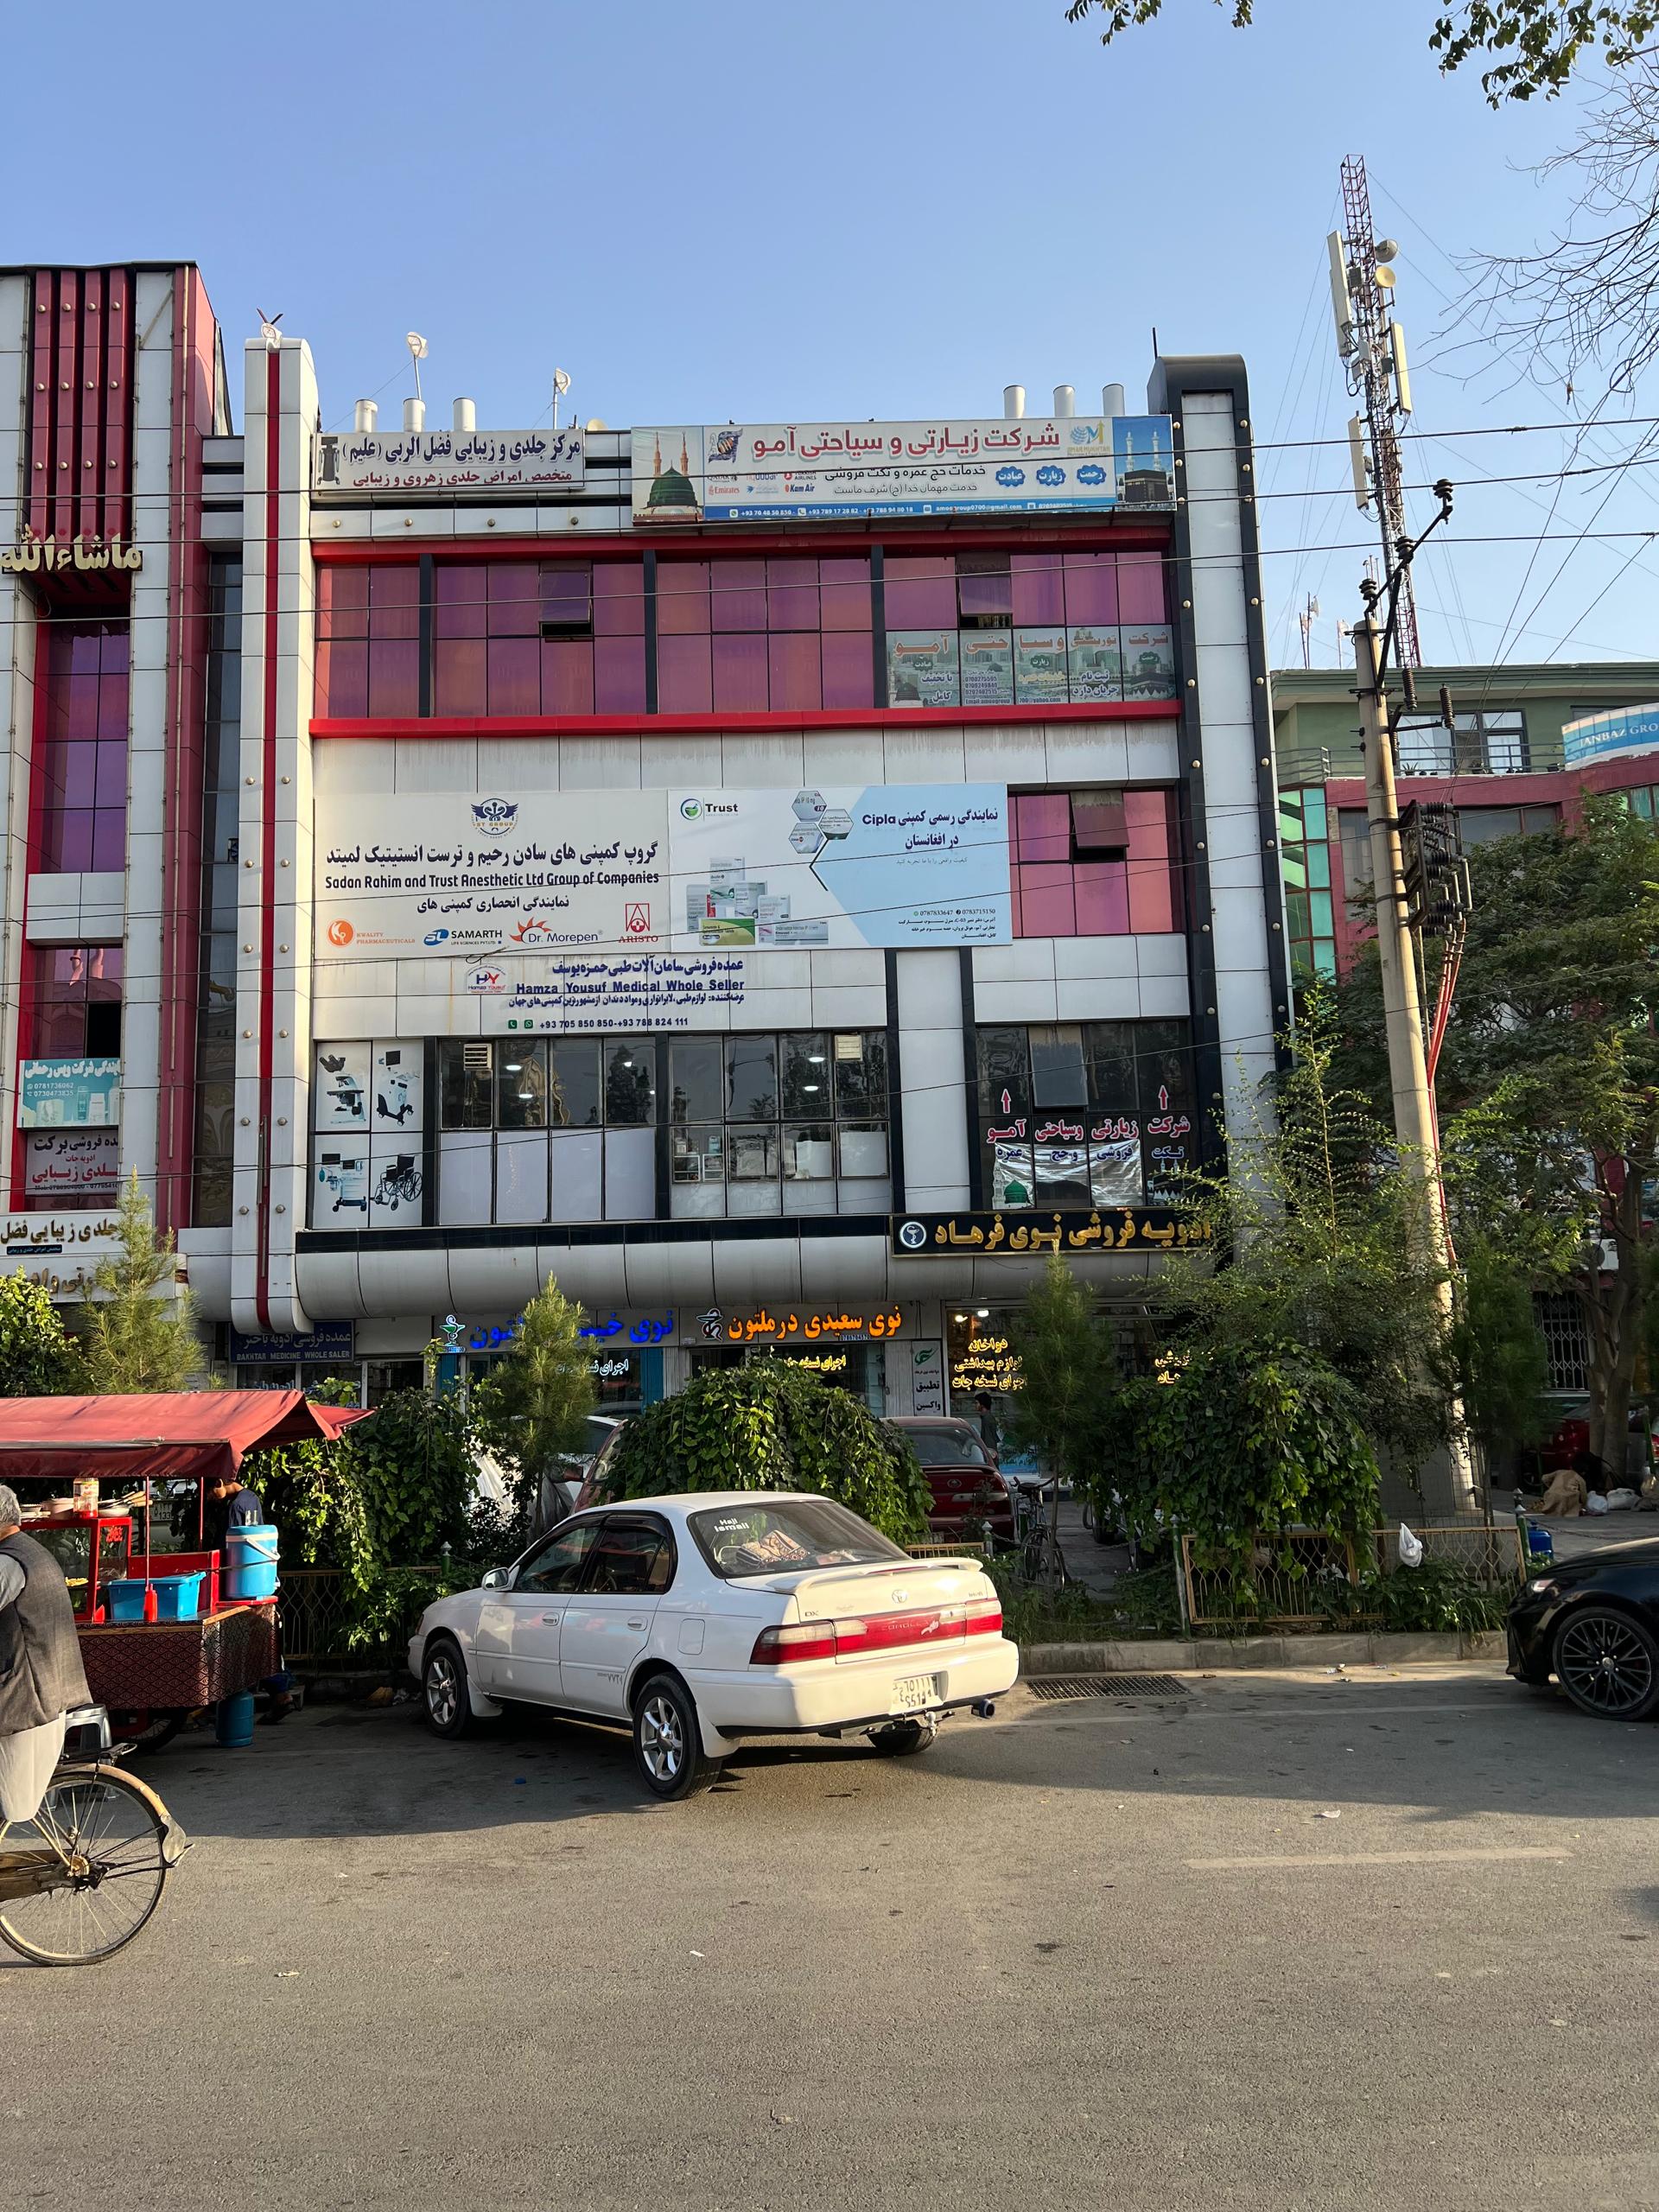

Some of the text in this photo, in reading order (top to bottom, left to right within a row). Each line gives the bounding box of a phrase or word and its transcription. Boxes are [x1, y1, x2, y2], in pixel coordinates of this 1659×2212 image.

[385, 435, 420, 462] الربی
[423, 433, 452, 462] فضل
[455, 435, 495, 461] زیبایی
[510, 436, 546, 462] جلدی
[550, 434, 581, 462] مرکز
[753, 423, 1060, 458] شرکت زیارتی و سیاحتی آمو
[499, 444, 505, 461] و
[903, 468, 928, 480] عمره
[931, 467, 946, 481] حج
[949, 463, 986, 476] خدمات
[998, 471, 1023, 481] عبادت
[1039, 469, 1063, 482] زیارت
[1079, 469, 1103, 480] رحمت
[790, 484, 804, 493] Kam
[804, 483, 816, 493] Air
[919, 483, 948, 493] مهمان
[950, 483, 977, 493] خدمت
[1128, 631, 1169, 647] شرکت
[1081, 670, 1110, 683] ثبت نام
[932, 690, 951, 703] کامل
[1580, 721, 1659, 748] JANBAZ GRO
[705, 803, 739, 812] Trust
[861, 813, 896, 827] Cipla
[898, 808, 998, 827] نمایندگی رسمی کمپنی
[905, 832, 959, 850] در افغانستان
[327, 840, 658, 868] گروپ کمپنی های سادن رحیم و ترست لمیتد
[325, 870, 659, 889] Sadan Rahim and Trust Anesthetic Ltd Group of Companies
[416, 895, 569, 913] نمایندگی انحصاری کمپنی های
[451, 930, 503, 939] SAMARTH
[528, 932, 599, 944] Dr. Morepen
[618, 935, 659, 944] ARISTO
[607, 959, 632, 976] طبی
[654, 957, 684, 975] سامان
[683, 957, 717, 976] فروشی
[516, 979, 745, 995] Hamza Yousuf Medical Whole Seller
[539, 1017, 689, 1029] +93 705 850 788 824 111
[986, 1118, 1027, 1144] آمو
[1090, 1116, 1140, 1141] زیارتی
[1147, 1116, 1192, 1138] شرکت
[34, 1134, 102, 1155] فروشی برکت
[1096, 1145, 1134, 1161] فروشی
[1151, 1146, 1185, 1160] تکت
[996, 1147, 1024, 1162] عمره
[32, 1164, 79, 1184] زیبایی
[934, 1212, 1005, 1250] فرهاد
[1009, 1213, 1063, 1249] نوی
[1069, 1211, 1136, 1248] فروشی
[628, 1309, 674, 1344] نوی
[804, 1311, 863, 1339] سعیدی
[868, 1304, 903, 1338] نوی
[325, 1332, 351, 1342] عمده
[968, 1337, 1008, 1354] دواخانه
[270, 1351, 302, 1360] MEDICINE
[304, 1351, 327, 1359] WHOLE
[328, 1350, 350, 1358] SALER
[821, 1354, 846, 1372] اجرای
[916, 1380, 940, 1393] تطبیق
[951, 1374, 998, 1391] نسخه جات
[916, 1401, 941, 1411] واکسین
[714, 1522, 751, 1533] Ismail
[719, 1517, 739, 1526] Haji
